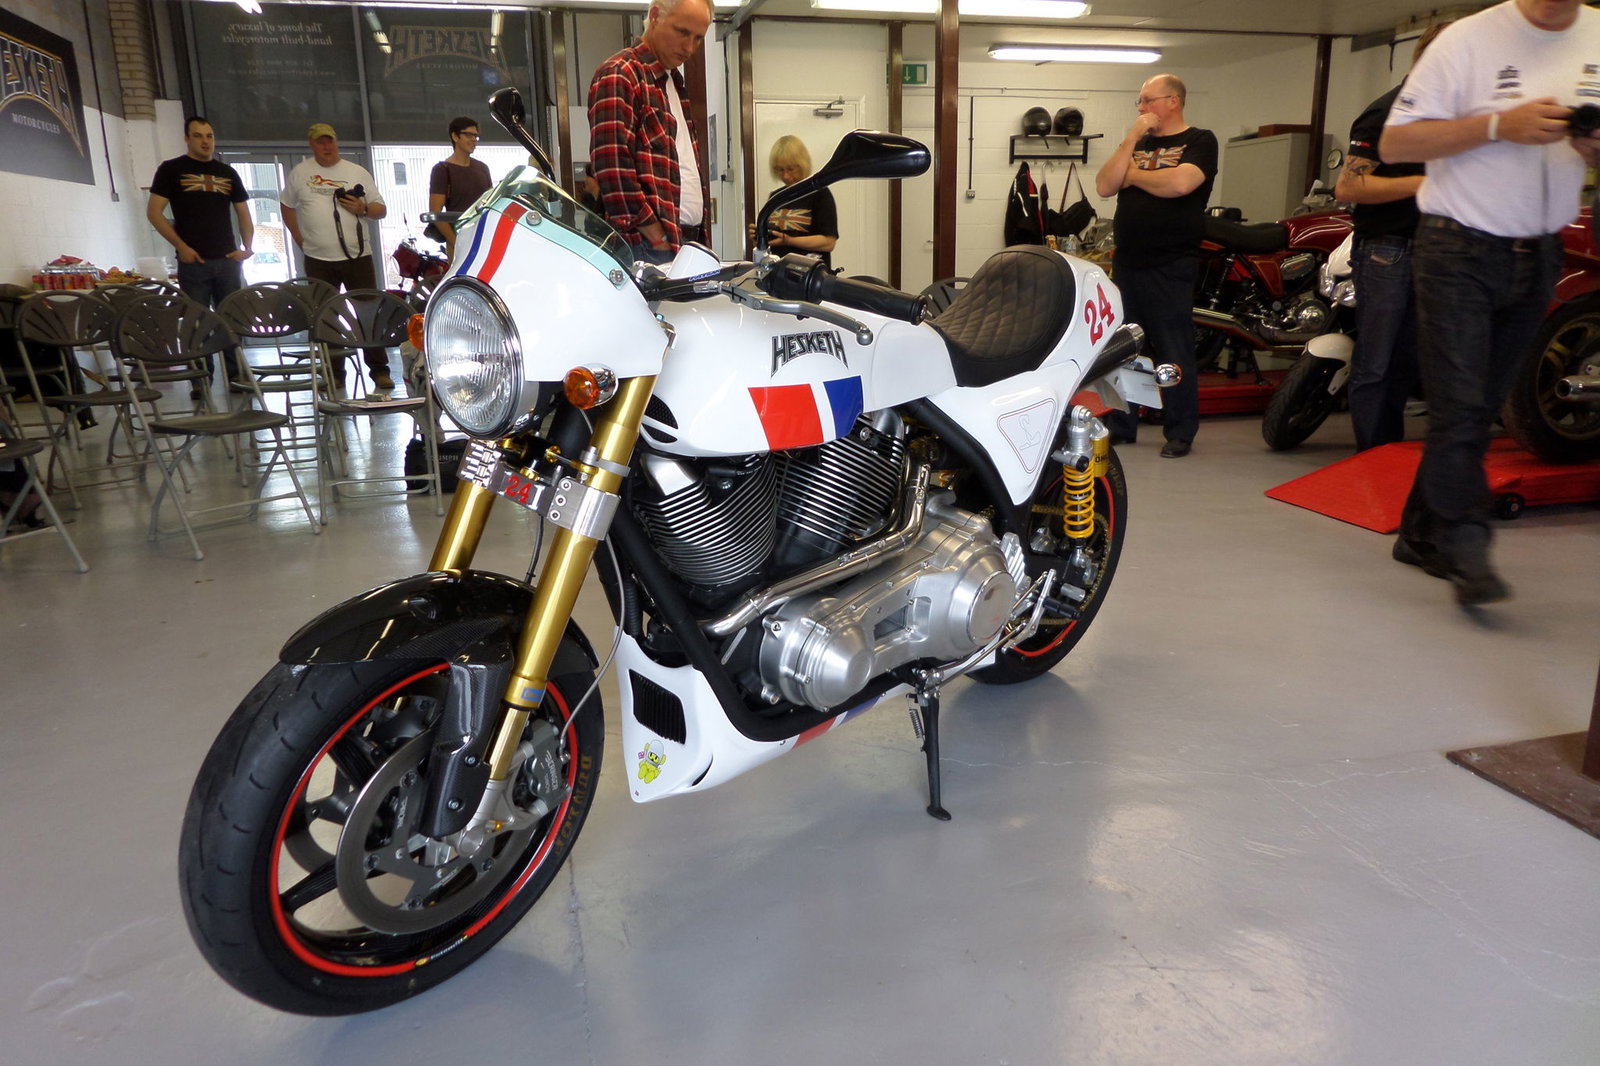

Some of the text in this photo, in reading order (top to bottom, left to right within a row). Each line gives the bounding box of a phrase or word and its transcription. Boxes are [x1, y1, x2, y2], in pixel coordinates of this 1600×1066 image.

[0, 32, 84, 158] ESKETH
[11, 112, 61, 135] MOTORCYCLES
[1084, 282, 1115, 346] 24
[770, 330, 849, 378] HESKETH
